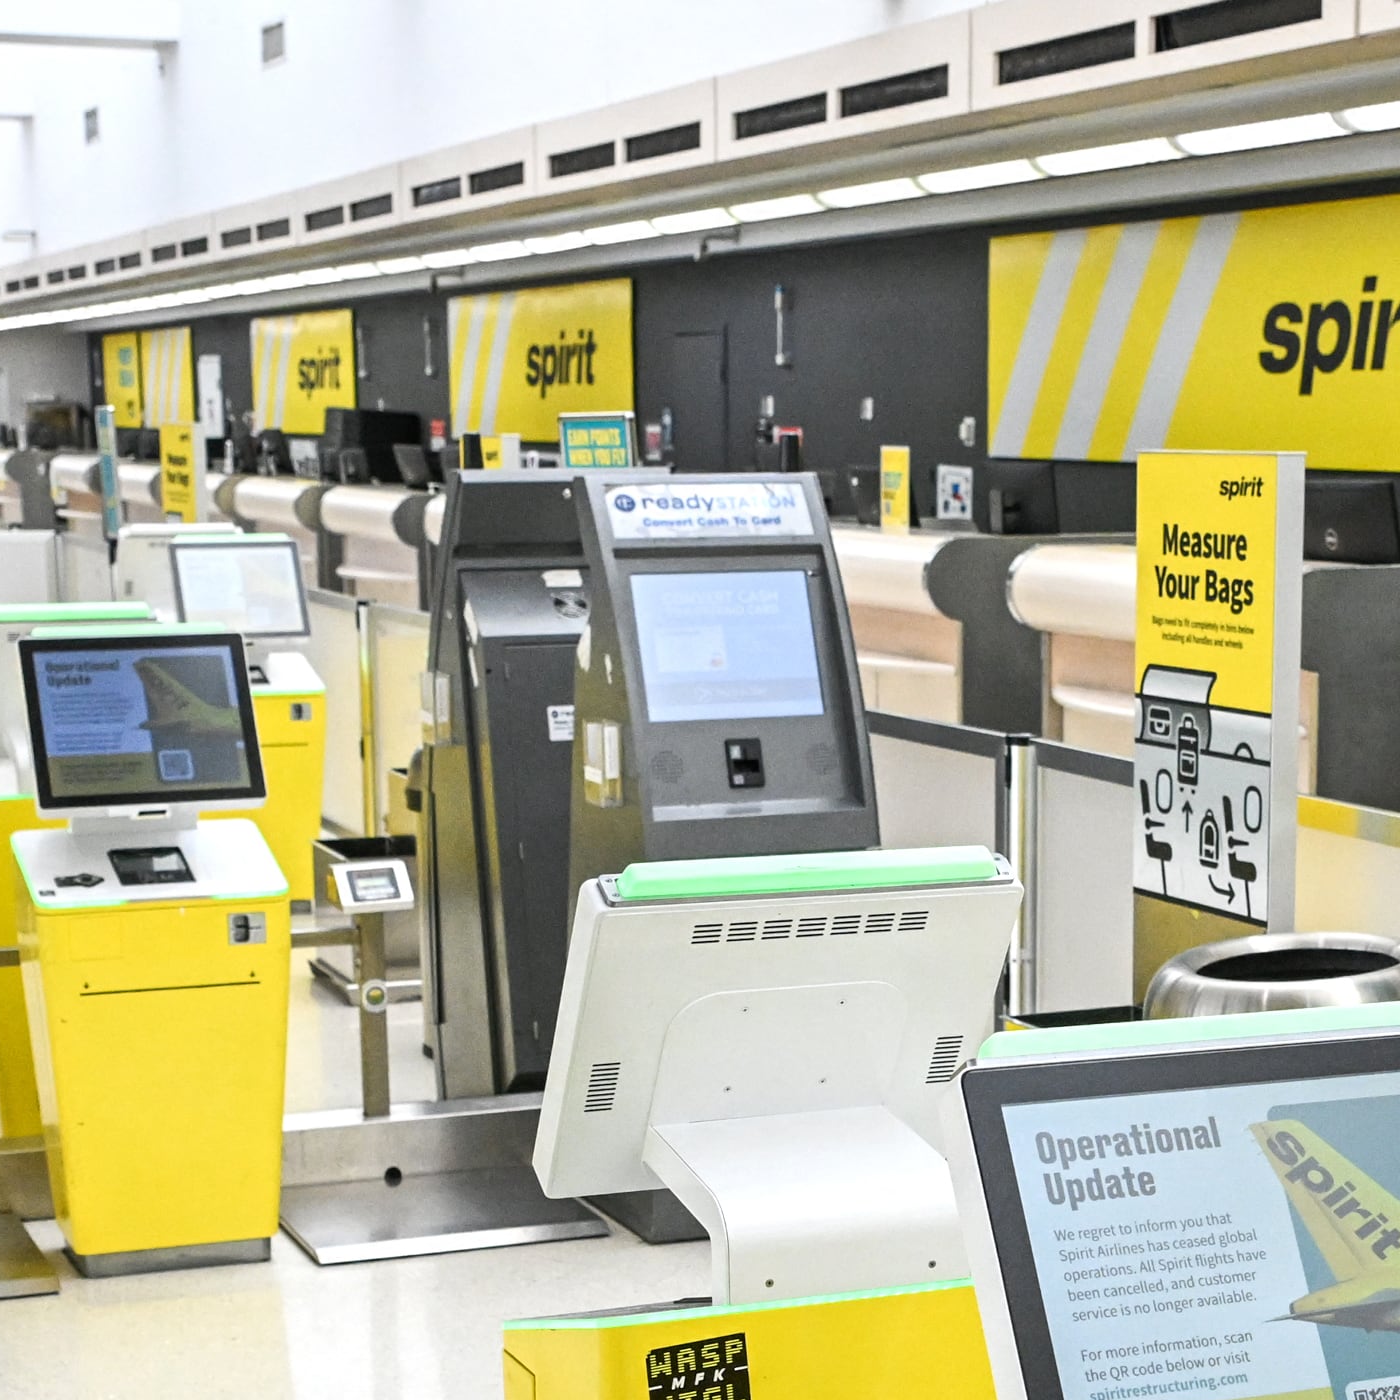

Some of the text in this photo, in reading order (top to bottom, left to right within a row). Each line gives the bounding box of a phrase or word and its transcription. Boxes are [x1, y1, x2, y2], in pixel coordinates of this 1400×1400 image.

[526, 328, 597, 399] spirit
[1219, 476, 1264, 501] spirit
[643, 516, 781, 527] Convert Cash To Card
[1162, 523, 1247, 561] Measure
[1154, 565, 1254, 615] Your Bags
[1035, 1116, 1221, 1170] Operational
[1043, 1166, 1156, 1211] Update
[650, 1339, 743, 1378] WASP
